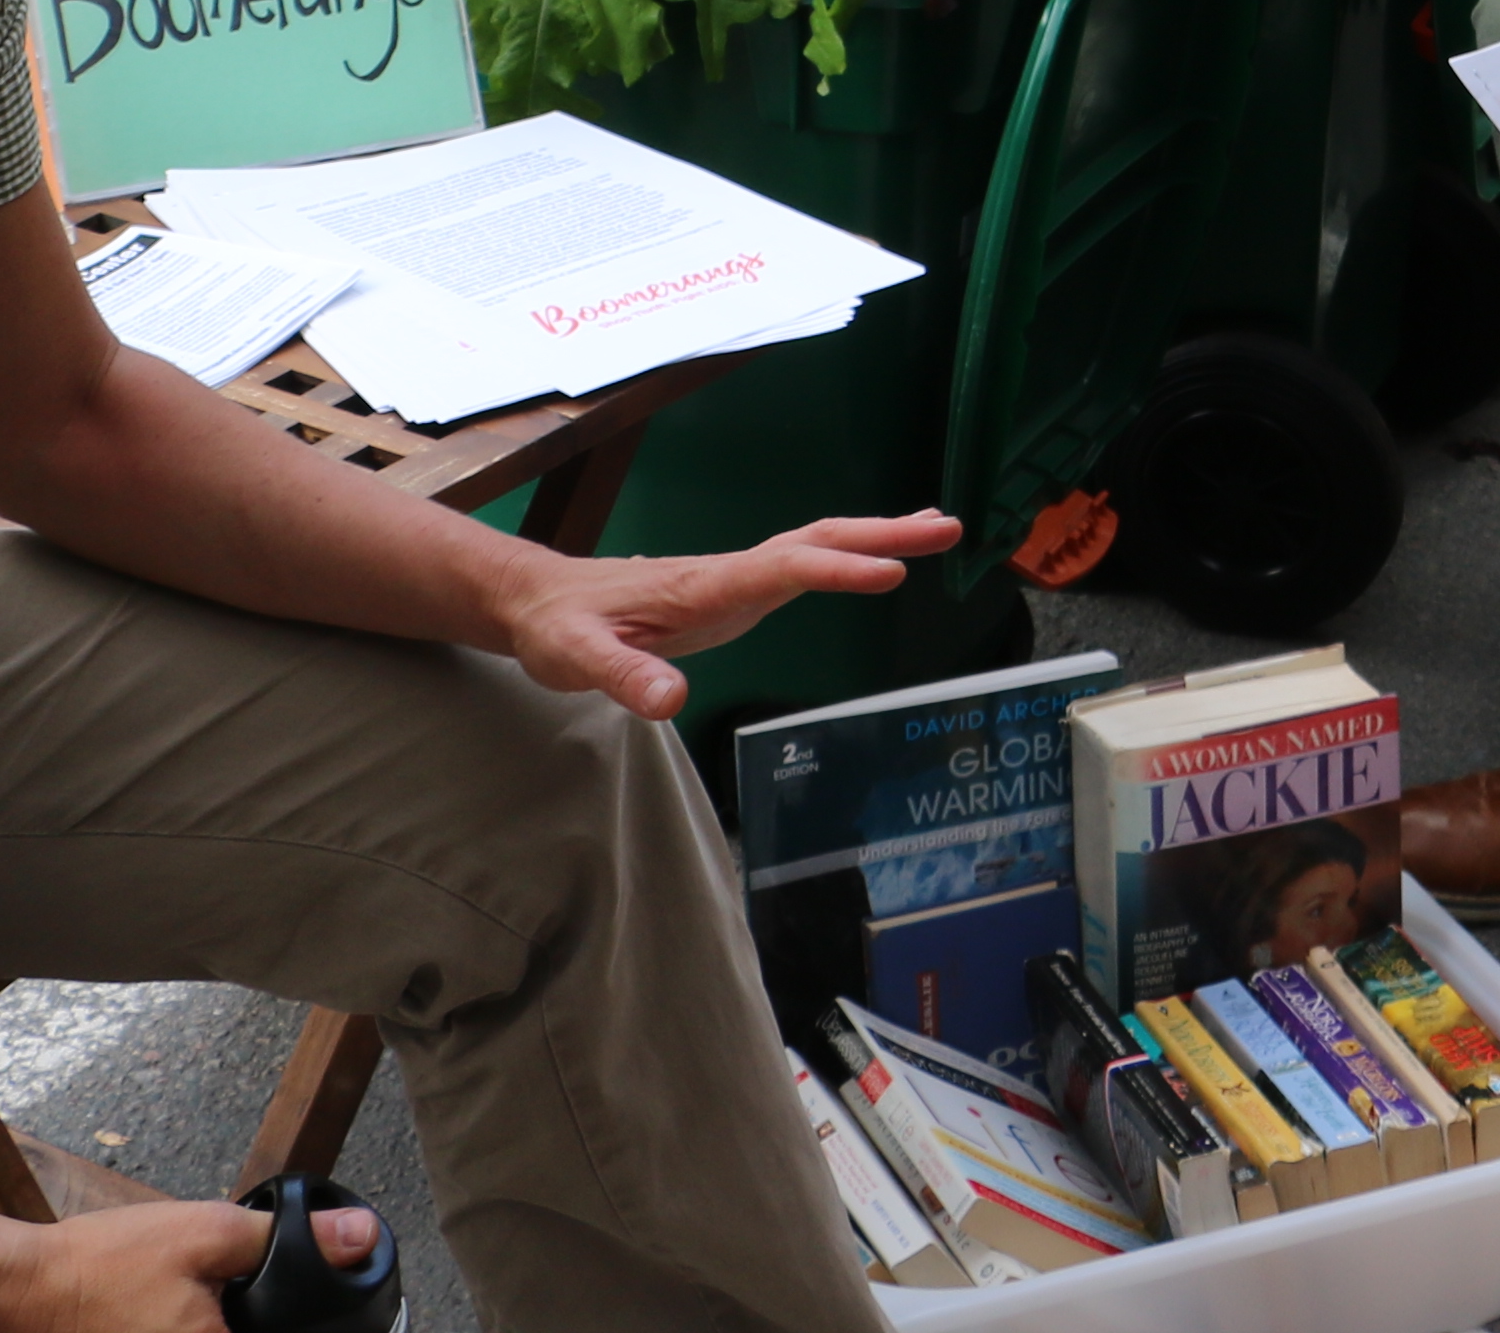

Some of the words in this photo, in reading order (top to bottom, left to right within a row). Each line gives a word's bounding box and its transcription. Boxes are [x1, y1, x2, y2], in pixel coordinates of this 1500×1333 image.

[529, 250, 766, 339] Boomerangs
[905, 708, 986, 742] DAVID
[1151, 759, 1166, 779] A
[1168, 736, 1278, 776] WOMAN
[1286, 712, 1384, 753] NAMED
[772, 760, 820, 782] EDITION
[781, 742, 814, 765] 2nd
[949, 733, 1071, 779] GLOBA
[907, 766, 1072, 826] WARMIN
[1139, 739, 1382, 854] JACKIE
[858, 821, 987, 863] Understanding
[993, 815, 1019, 834] the
[1133, 937, 1187, 956] BIOGRAPHY
[1314, 994, 1343, 1040] NORA
